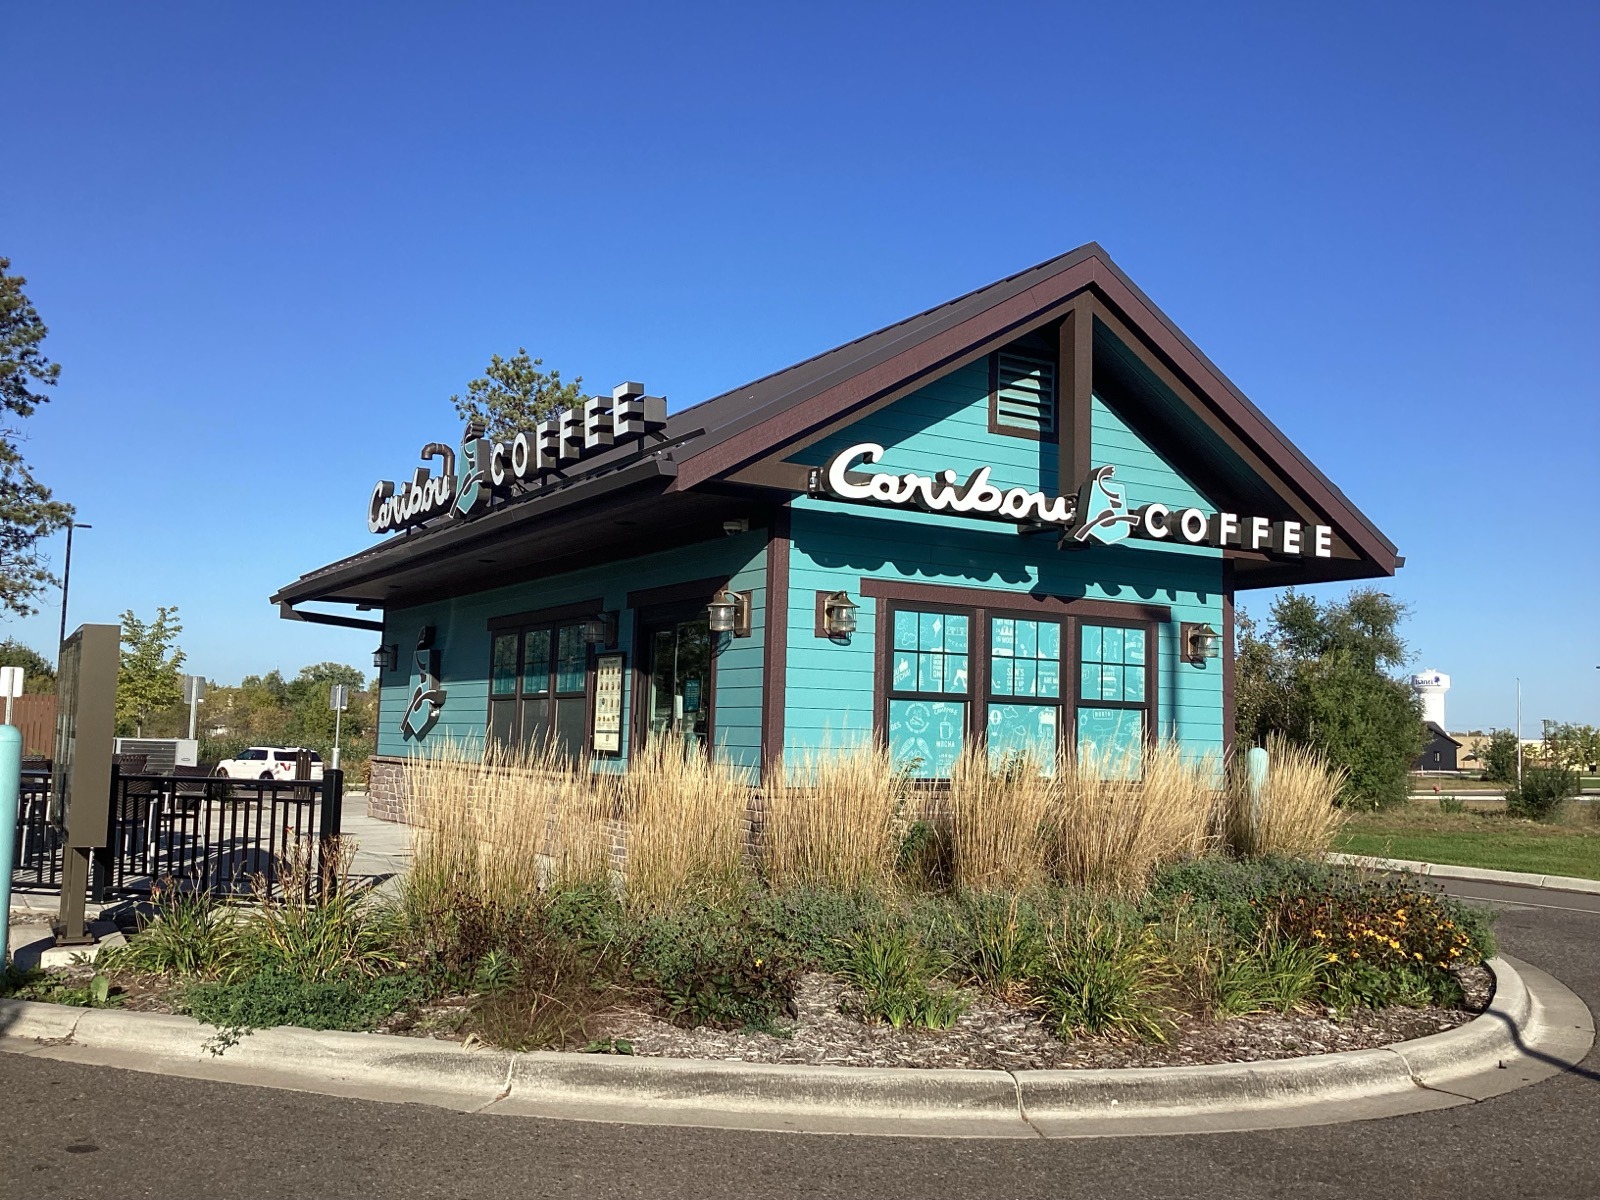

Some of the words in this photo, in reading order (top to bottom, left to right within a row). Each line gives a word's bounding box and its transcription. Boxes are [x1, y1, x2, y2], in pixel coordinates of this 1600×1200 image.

[368, 467, 451, 533] Caribou
[491, 381, 644, 486] COFFEE
[827, 443, 1073, 522] Caribou
[1144, 505, 1332, 558] COFFEE
